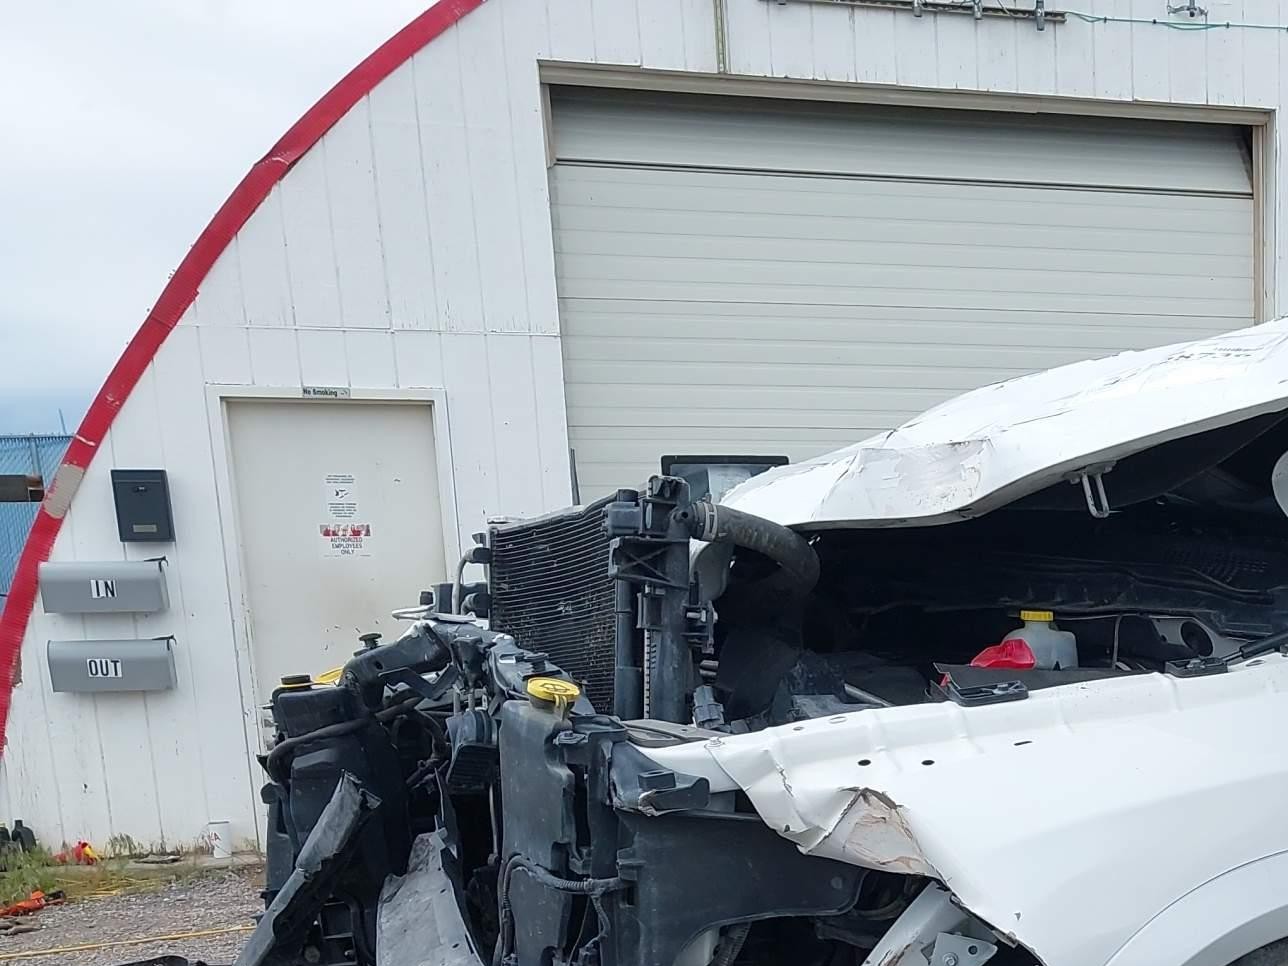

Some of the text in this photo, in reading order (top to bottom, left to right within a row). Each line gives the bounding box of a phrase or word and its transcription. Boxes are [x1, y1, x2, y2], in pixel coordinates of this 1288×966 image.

[303, 387, 312, 395] No
[95, 580, 116, 598] IN
[88, 660, 120, 677] OUT
